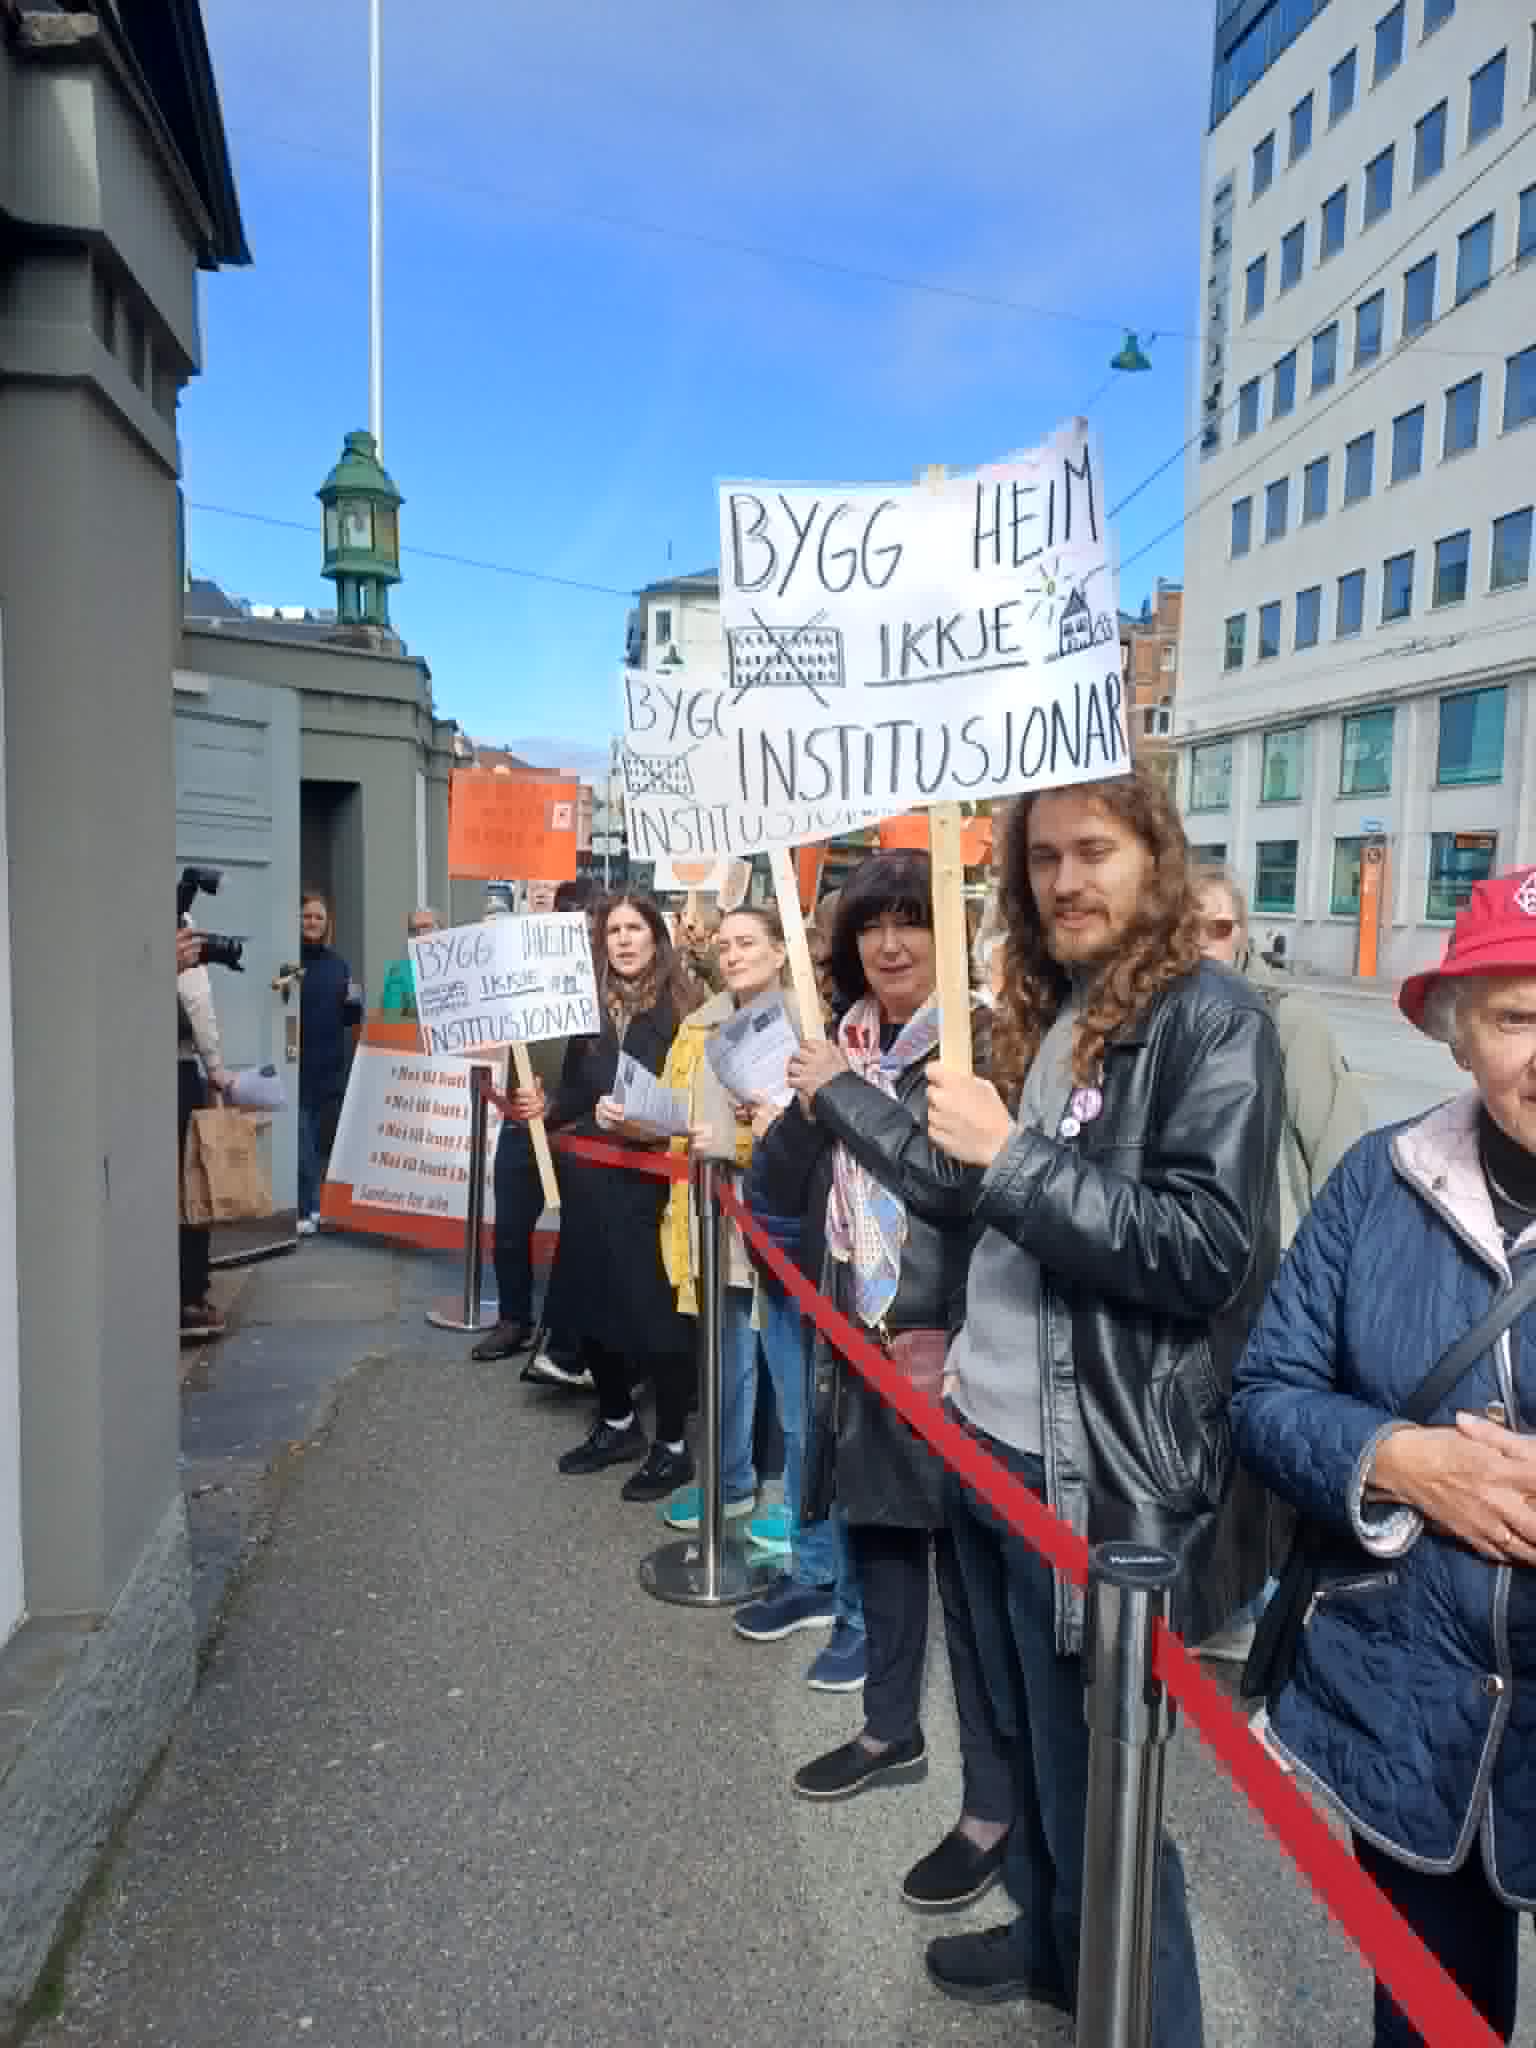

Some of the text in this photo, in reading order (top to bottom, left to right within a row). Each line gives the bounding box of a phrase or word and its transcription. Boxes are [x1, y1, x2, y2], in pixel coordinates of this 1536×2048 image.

[729, 443, 1099, 597] BYGG HEIM
[879, 599, 1022, 679] IKKJE
[737, 676, 1128, 806] INSTITUSJONAR
[416, 919, 593, 980] BYGG HEIM
[479, 969, 538, 995] IKKJE
[422, 999, 593, 1055] INSTITUSJONAR
